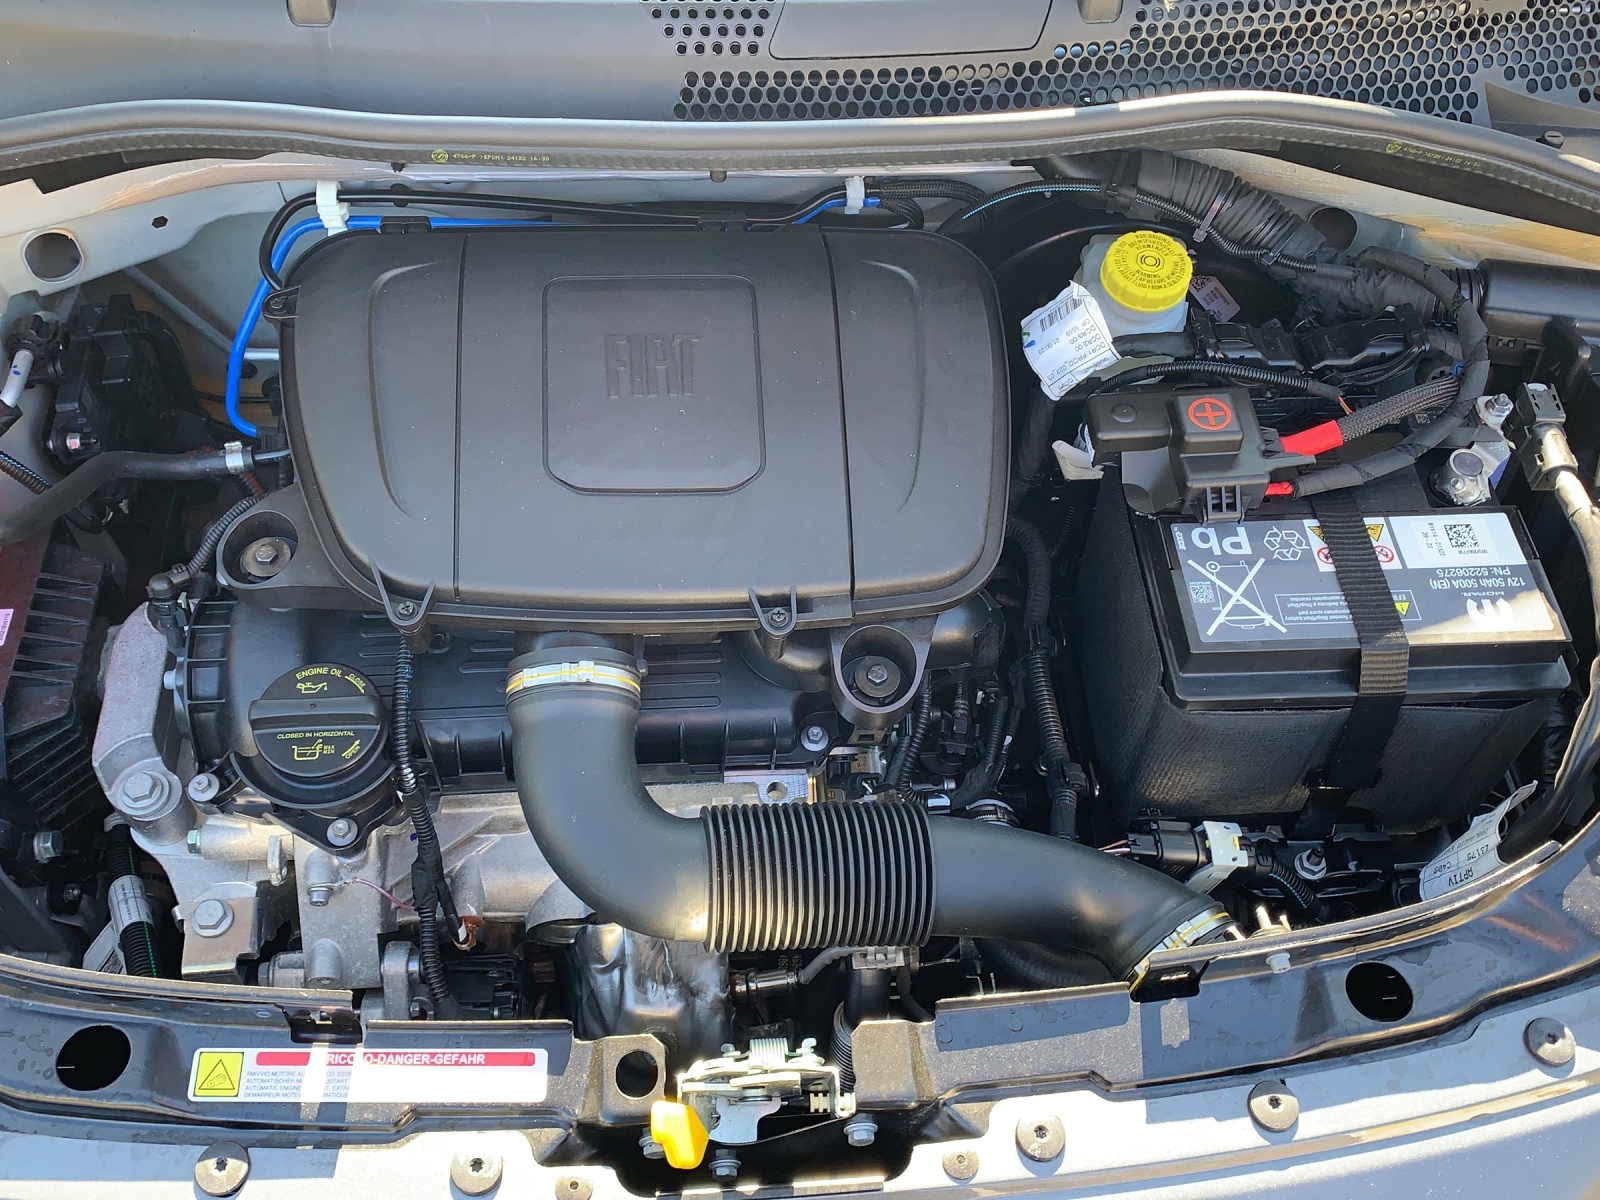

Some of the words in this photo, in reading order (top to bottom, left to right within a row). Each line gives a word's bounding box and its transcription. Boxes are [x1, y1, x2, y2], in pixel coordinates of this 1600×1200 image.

[1148, 234, 1172, 246] ORIGINAL
[1135, 244, 1168, 257] VERWENDEN
[1136, 270, 1160, 278] WARNING
[604, 332, 699, 398] FIAT
[1191, 526, 1252, 555] Pb
[1436, 567, 1488, 577] 52206275
[1490, 566, 1511, 576] PN:
[1429, 578, 1450, 589] (EN)
[1453, 578, 1478, 588] 500A
[1479, 578, 1505, 588] 50Ah
[1507, 577, 1526, 587] 12V
[296, 667, 329, 680] ENGINE
[330, 668, 343, 677] OIL
[349, 673, 366, 687] CLOSE
[277, 732, 304, 740] CLOSED
[313, 730, 355, 738] HORIZONTAL
[344, 745, 360, 759] OPEN
[1448, 867, 1474, 887] APTIV
